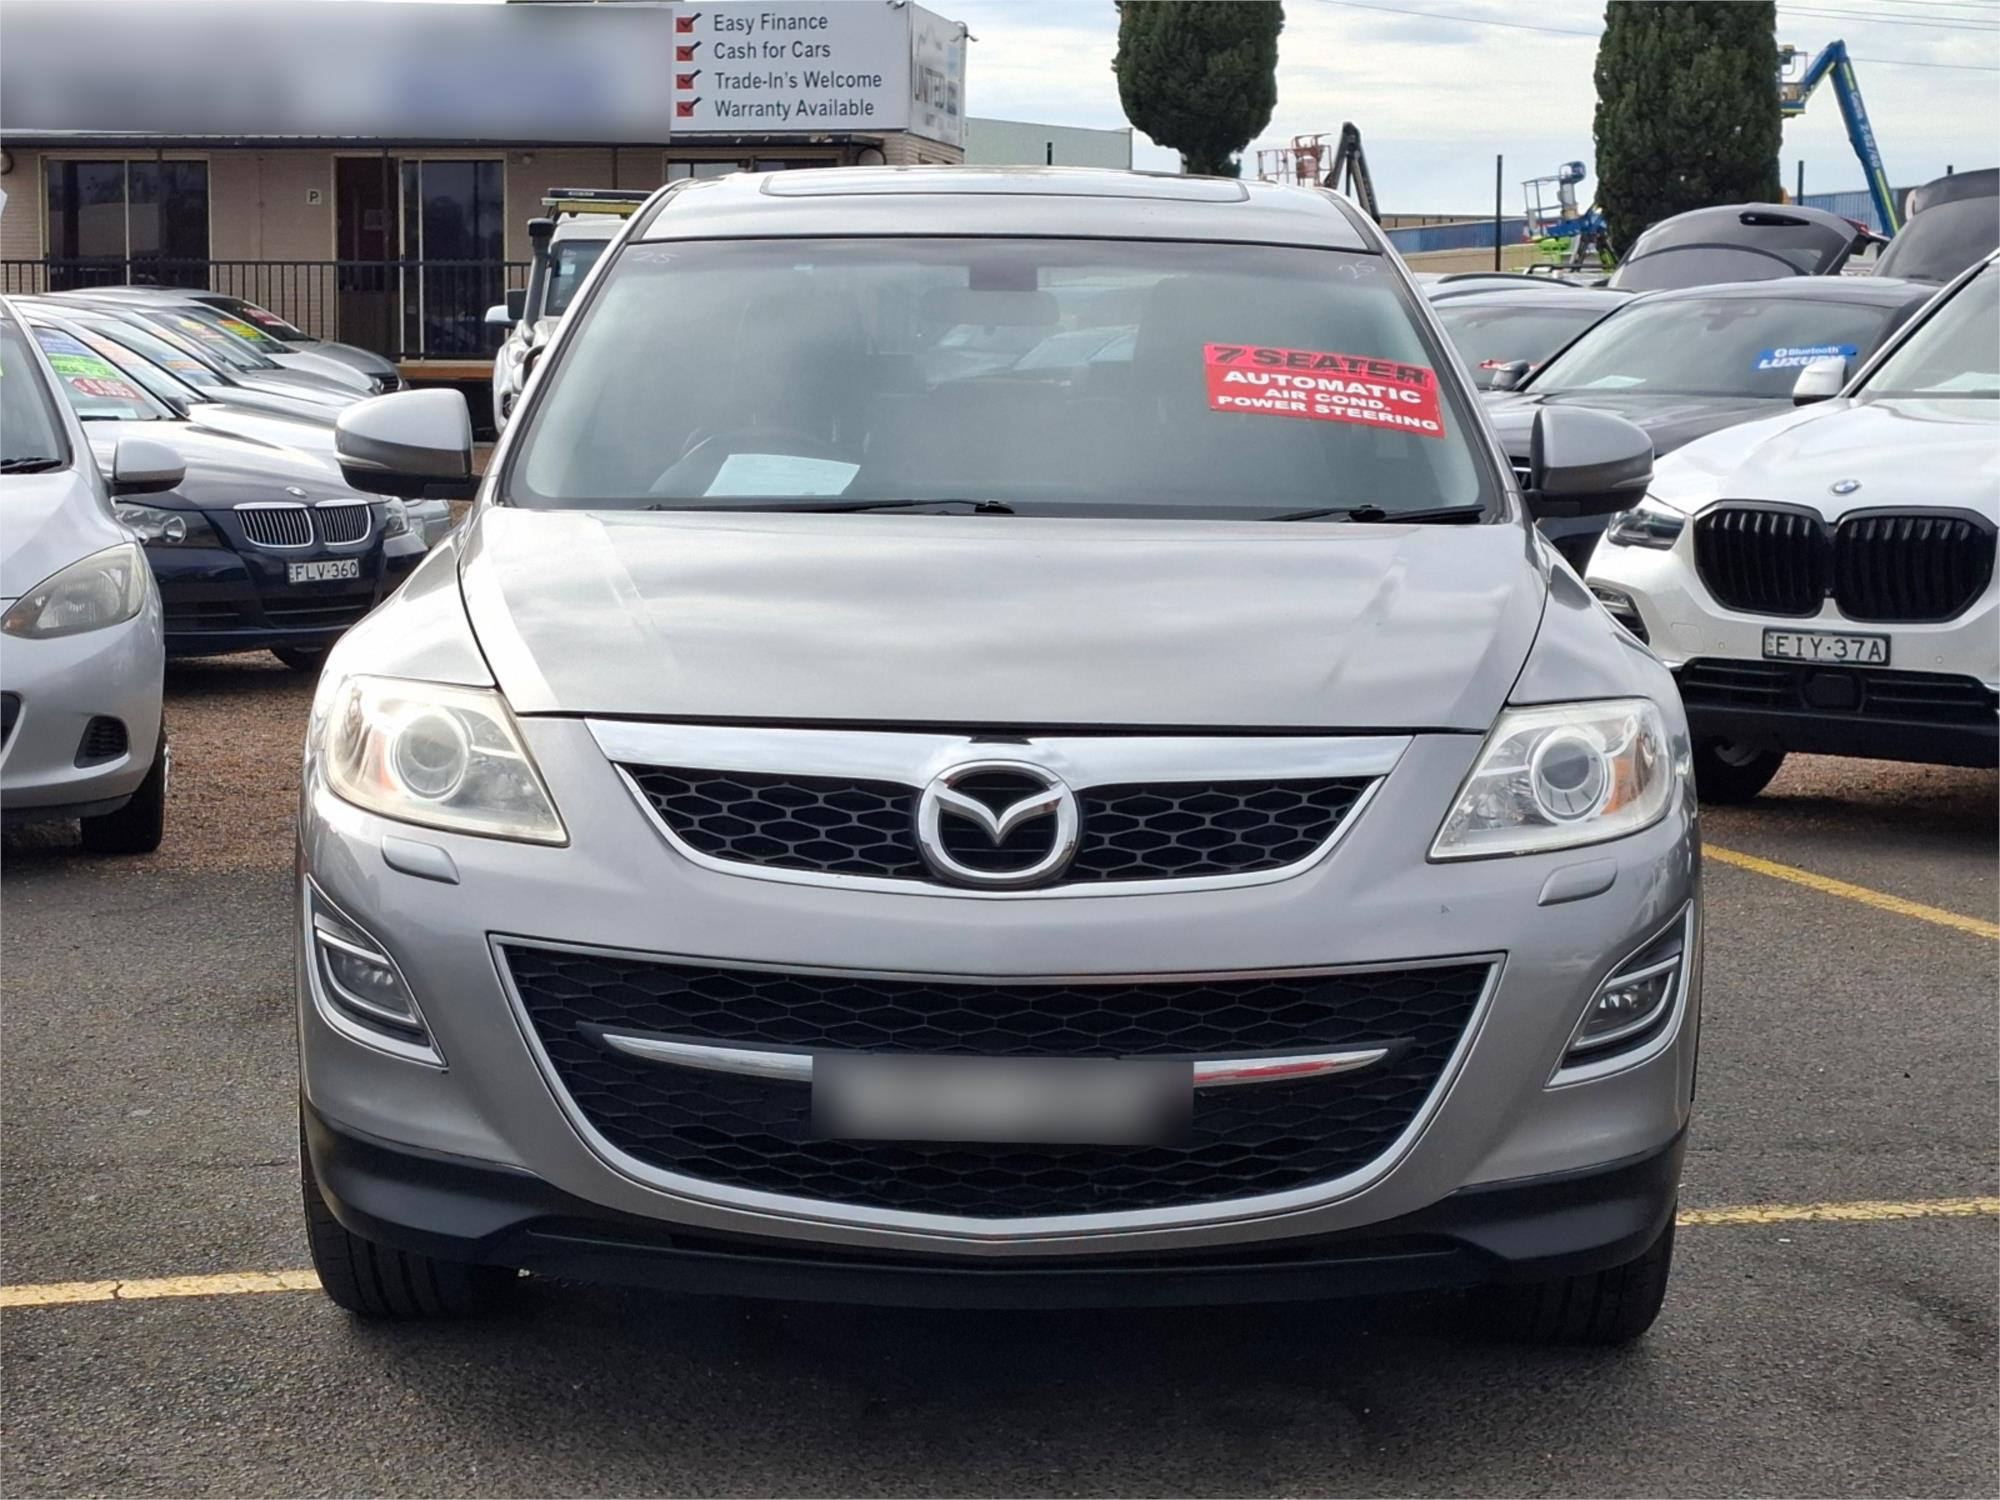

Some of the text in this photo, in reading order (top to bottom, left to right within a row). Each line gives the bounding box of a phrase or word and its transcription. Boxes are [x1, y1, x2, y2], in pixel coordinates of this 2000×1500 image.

[713, 13, 828, 35] Easy Finance
[713, 40, 831, 59] Cash for Cars
[714, 70, 882, 89] Trade-In's Welcome
[714, 97, 874, 121] Warranty Available
[309, 190, 319, 202] P
[1213, 346, 1429, 384] 7 SEATER
[1223, 371, 1422, 404] AUTOMATIC
[1264, 388, 1392, 411] AIR COND.
[1217, 395, 1440, 431] POWER STEERING
